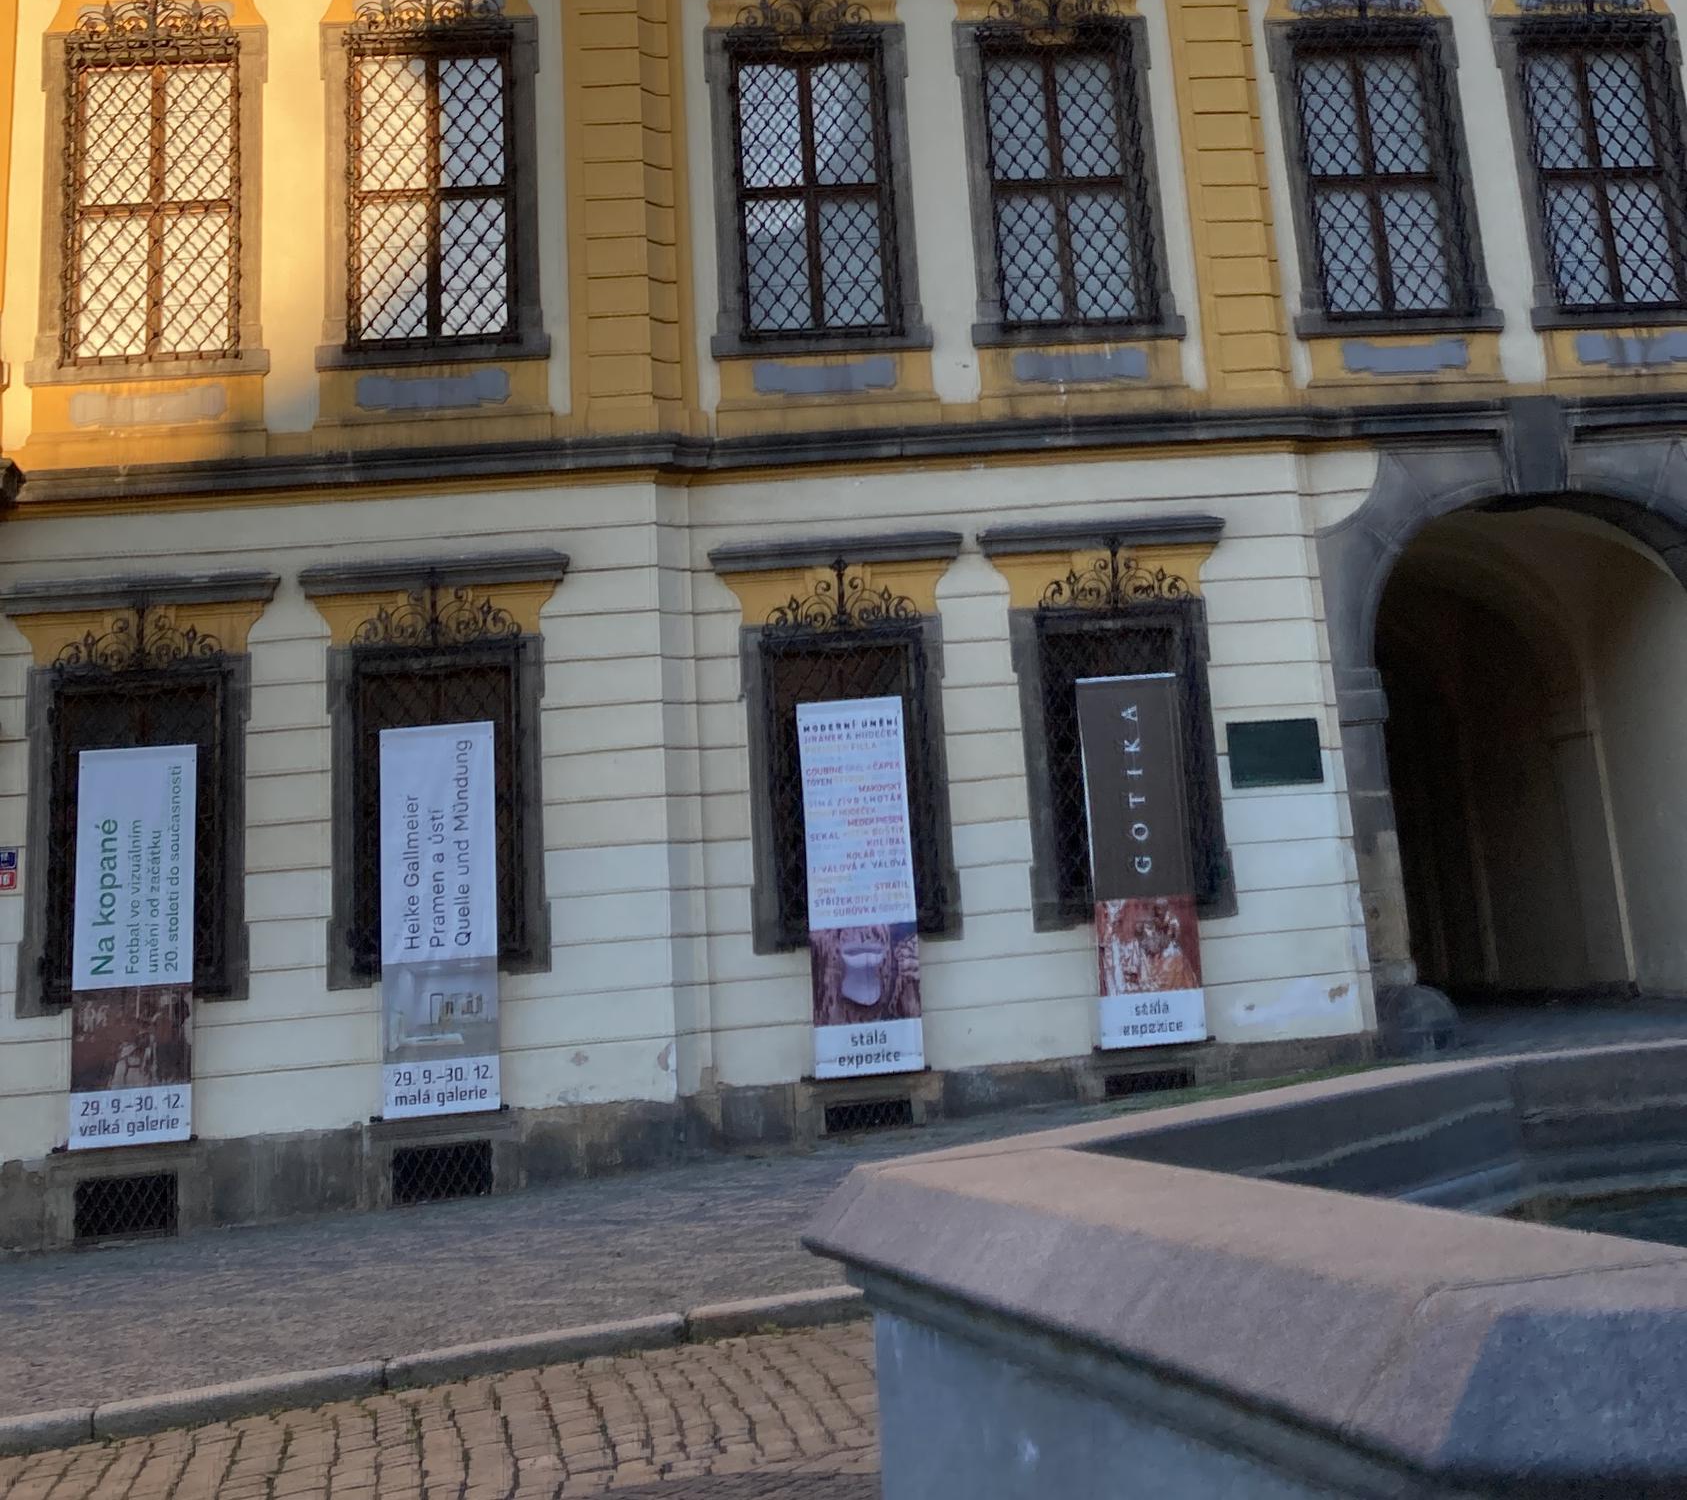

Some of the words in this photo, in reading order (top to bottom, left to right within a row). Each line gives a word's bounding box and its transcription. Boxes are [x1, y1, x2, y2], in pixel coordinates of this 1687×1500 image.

[452, 740, 472, 831] Mündung
[1120, 704, 1153, 874] GOTIKA
[167, 764, 183, 861] současnosti
[427, 808, 445, 845] ústí
[127, 820, 143, 896] vizuálním
[147, 829, 163, 893] začátku
[402, 794, 420, 887] Gallmeier
[432, 852, 444, 864] a
[452, 839, 470, 875] und
[92, 818, 122, 926] kopané
[166, 865, 181, 886] do
[129, 900, 142, 918] ve
[147, 898, 161, 918] od
[165, 891, 180, 943] století
[404, 894, 420, 950] Heike
[429, 871, 445, 949] Pramen
[453, 883, 472, 946] Quelle
[90, 935, 116, 976] Na
[125, 922, 141, 974] Fotbal
[145, 922, 160, 973] umění
[164, 946, 179, 973] 20.
[850, 1028, 887, 1047] stálá
[394, 1070, 416, 1087] 29.
[473, 1064, 494, 1080] 12.
[838, 1048, 900, 1069] expozice
[79, 1100, 104, 1117] 29.
[163, 1092, 185, 1109] 12.
[394, 1088, 431, 1107] malá
[436, 1085, 489, 1107] galerie
[79, 1118, 121, 1137] velká
[126, 1115, 180, 1137] galerie
